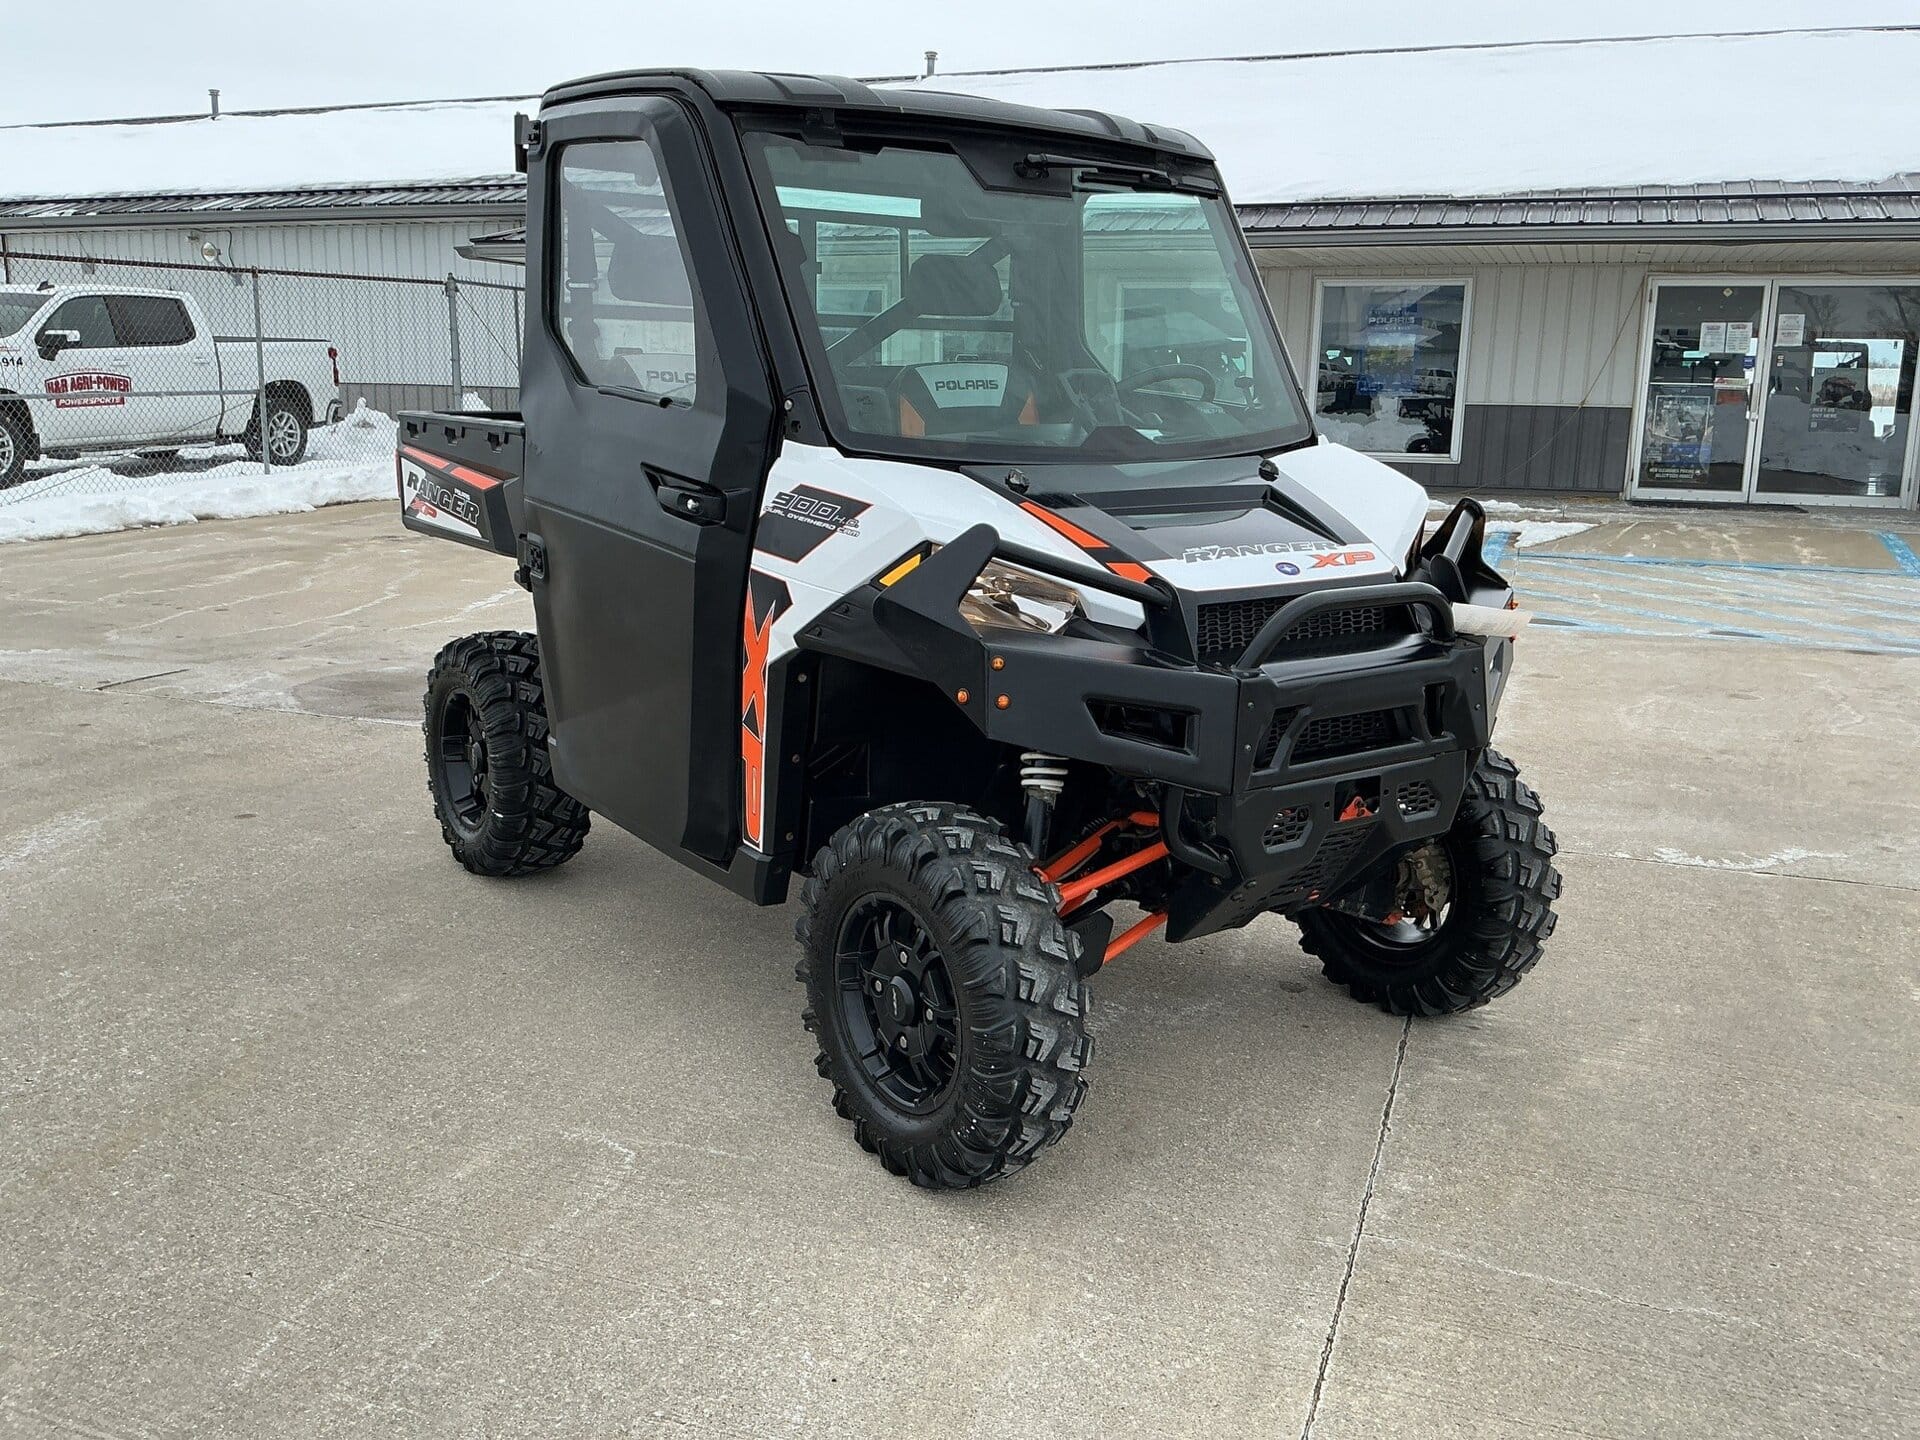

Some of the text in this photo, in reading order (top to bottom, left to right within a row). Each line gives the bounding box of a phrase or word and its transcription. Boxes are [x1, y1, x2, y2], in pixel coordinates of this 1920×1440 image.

[70, 375, 130, 393] AGRI-POWER
[934, 379, 999, 391] POLARIS
[406, 470, 480, 526] RANGER
[771, 490, 842, 521] 900
[763, 505, 785, 517] DUAL
[786, 512, 836, 531] OVERHEAD
[1183, 540, 1340, 564] RANGER
[1306, 551, 1377, 570] XP
